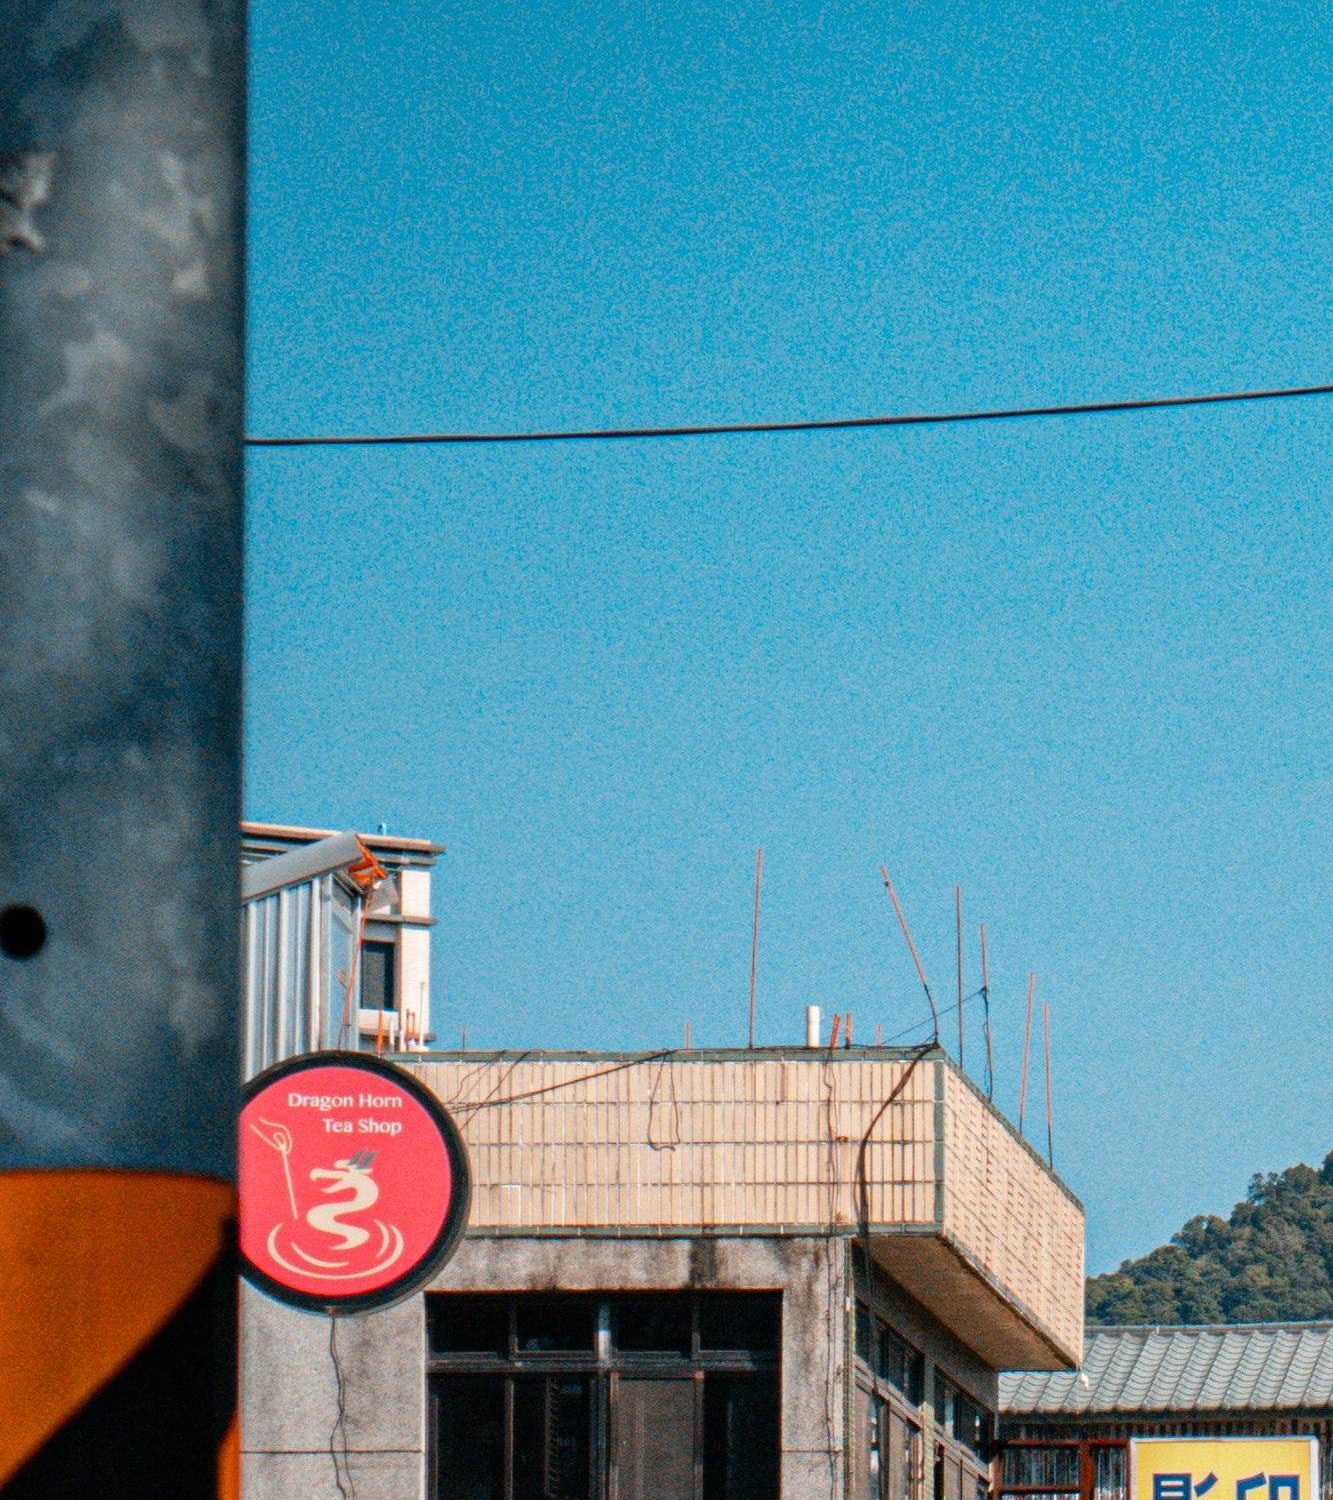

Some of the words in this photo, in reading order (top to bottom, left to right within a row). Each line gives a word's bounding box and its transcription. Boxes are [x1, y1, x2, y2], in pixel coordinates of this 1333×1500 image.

[287, 1093, 354, 1111] Dragon
[359, 1093, 402, 1108] Horn
[322, 1117, 353, 1133] Tea
[358, 1117, 403, 1136] Shop
